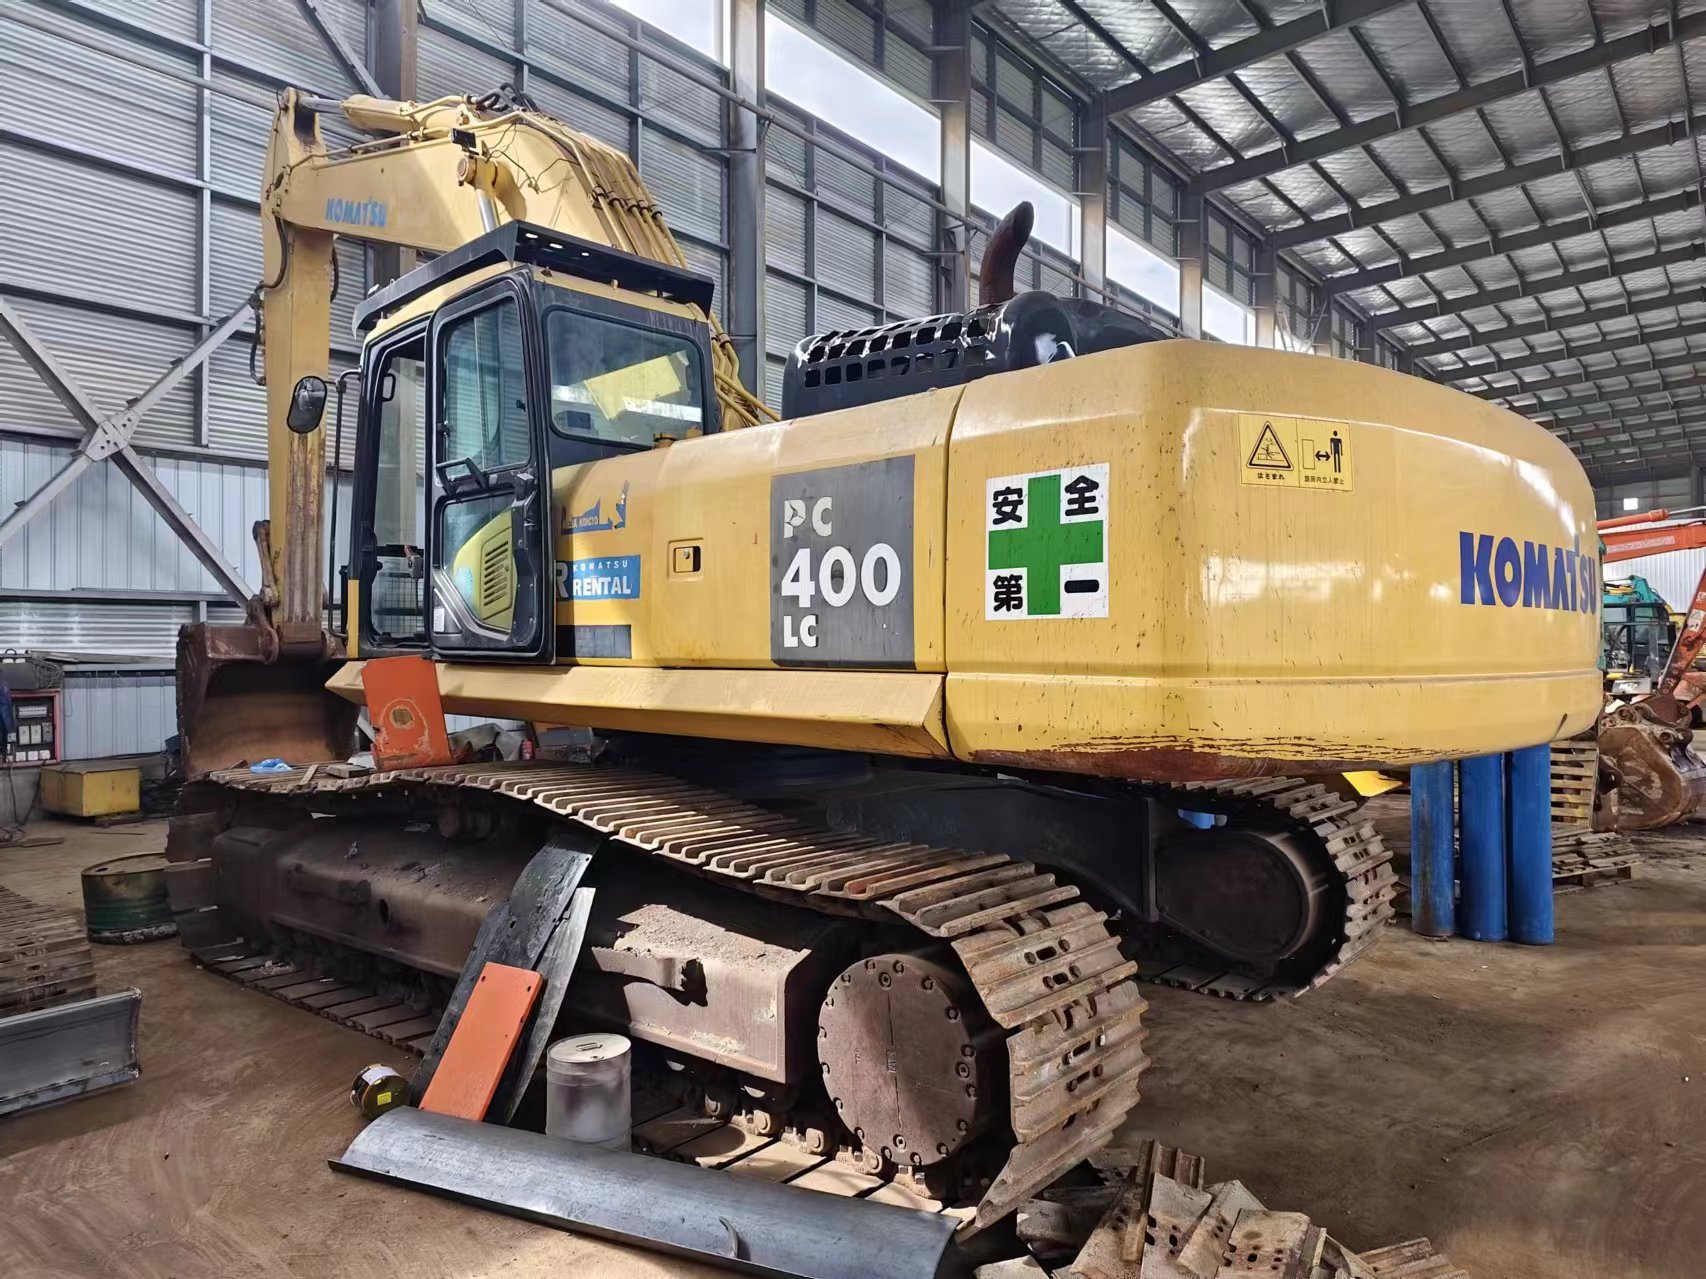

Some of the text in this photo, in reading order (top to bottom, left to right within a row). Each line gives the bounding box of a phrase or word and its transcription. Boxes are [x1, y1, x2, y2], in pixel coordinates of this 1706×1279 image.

[325, 196, 387, 227] KOMATSU
[784, 496, 833, 538] PC
[573, 559, 628, 572] KOMATSU
[781, 543, 901, 608] 400
[1459, 531, 1597, 615] KOMATSU
[573, 576, 632, 597] RENTAL
[784, 614, 818, 647] LC
